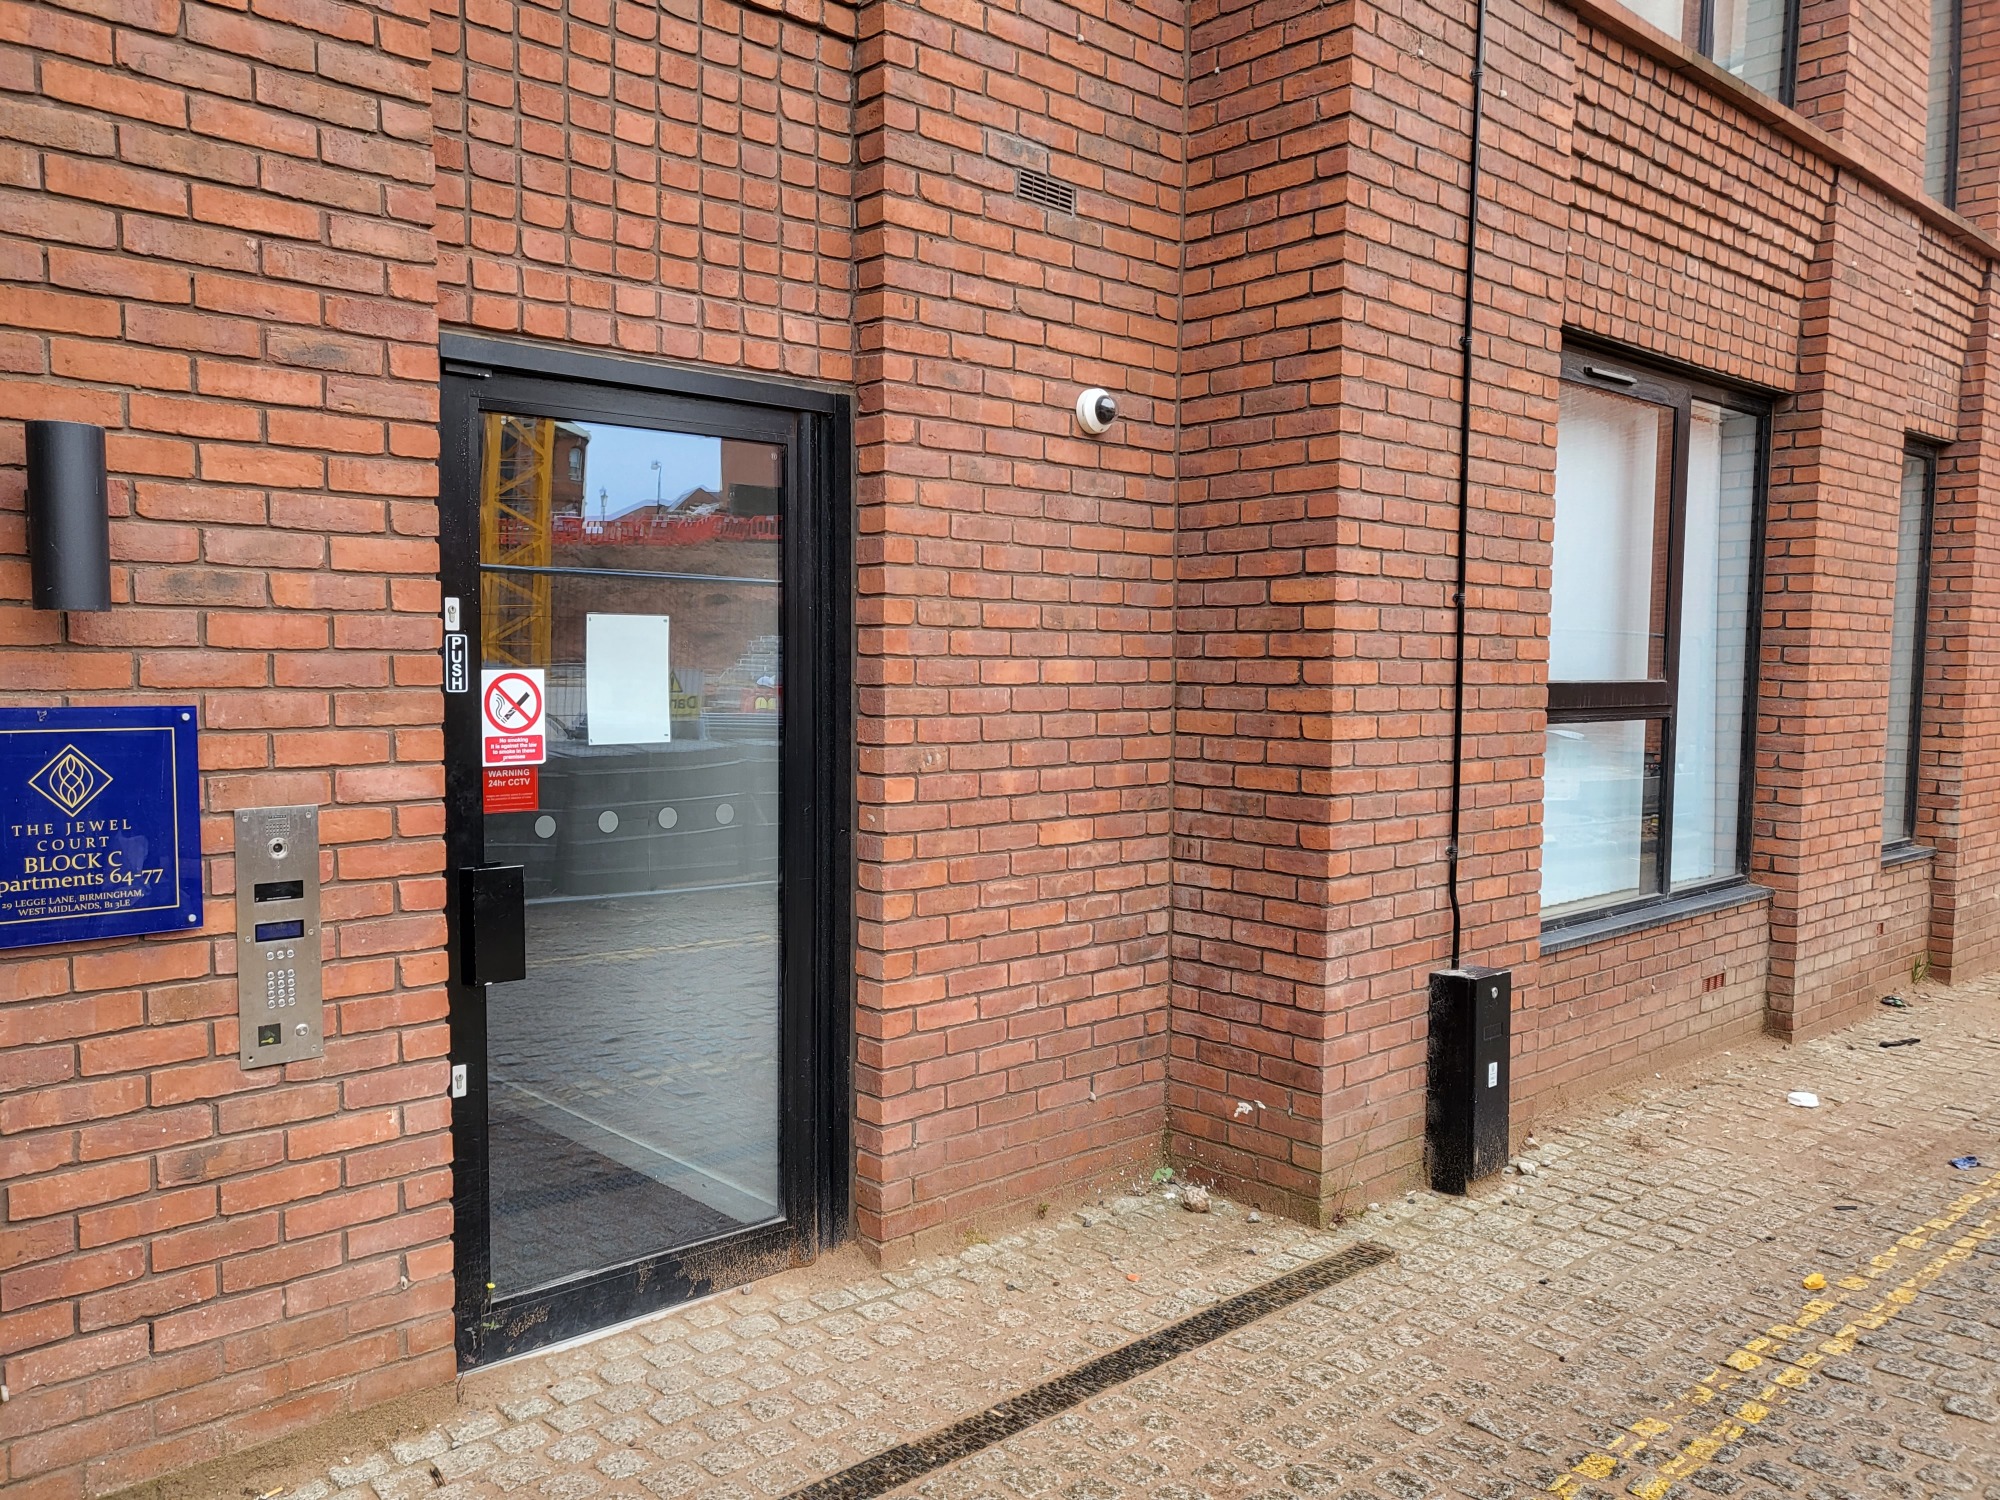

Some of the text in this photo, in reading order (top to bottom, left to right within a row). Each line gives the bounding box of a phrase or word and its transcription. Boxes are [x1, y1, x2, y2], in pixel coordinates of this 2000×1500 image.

[451, 636, 463, 690] PUSH
[488, 768, 530, 777] WARNING
[488, 778, 530, 787] 24hr CCTV
[11, 819, 132, 837] THE JEWEL
[37, 836, 109, 852] COURT
[24, 851, 123, 874] BLOCK C
[0, 868, 164, 898] partments 64-77
[2, 889, 145, 910] 29 LEGGE LANE, BIRMINGHAM,
[18, 899, 131, 917] WEST MIDLANDS, B1 3LE
